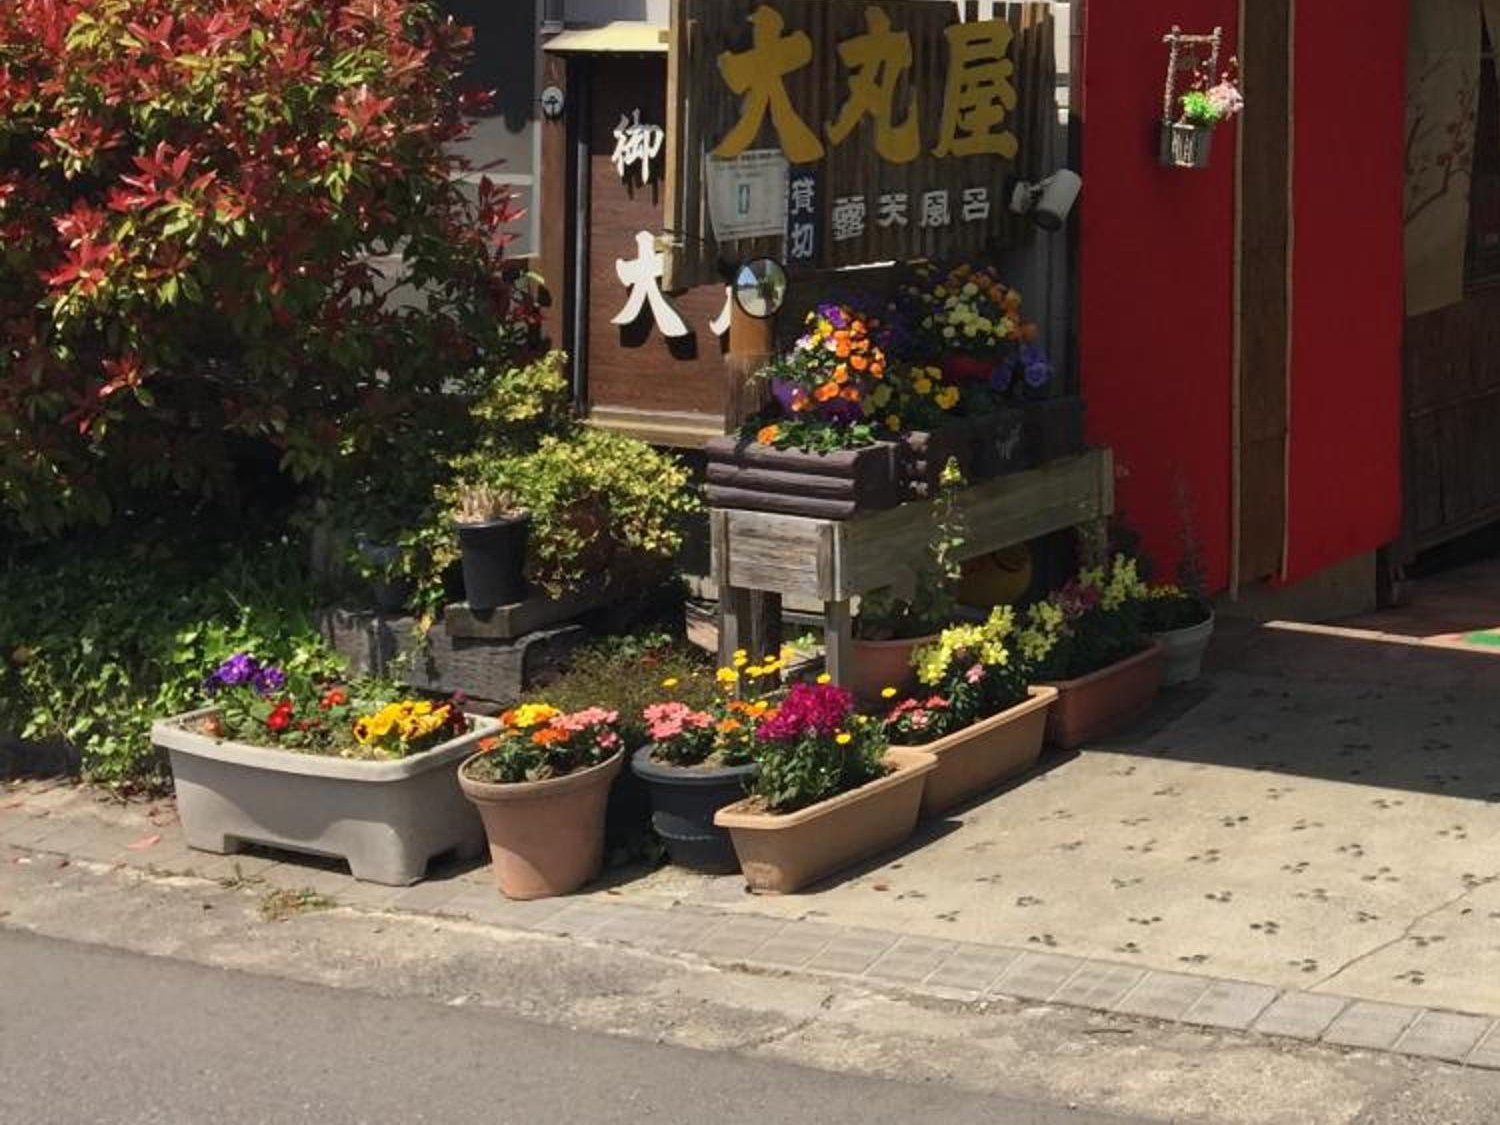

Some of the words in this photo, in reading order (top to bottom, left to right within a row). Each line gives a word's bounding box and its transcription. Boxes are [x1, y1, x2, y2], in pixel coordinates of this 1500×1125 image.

[713, 5, 1018, 163] 大丸屋
[611, 108, 665, 185] 御
[611, 231, 732, 337] 大
